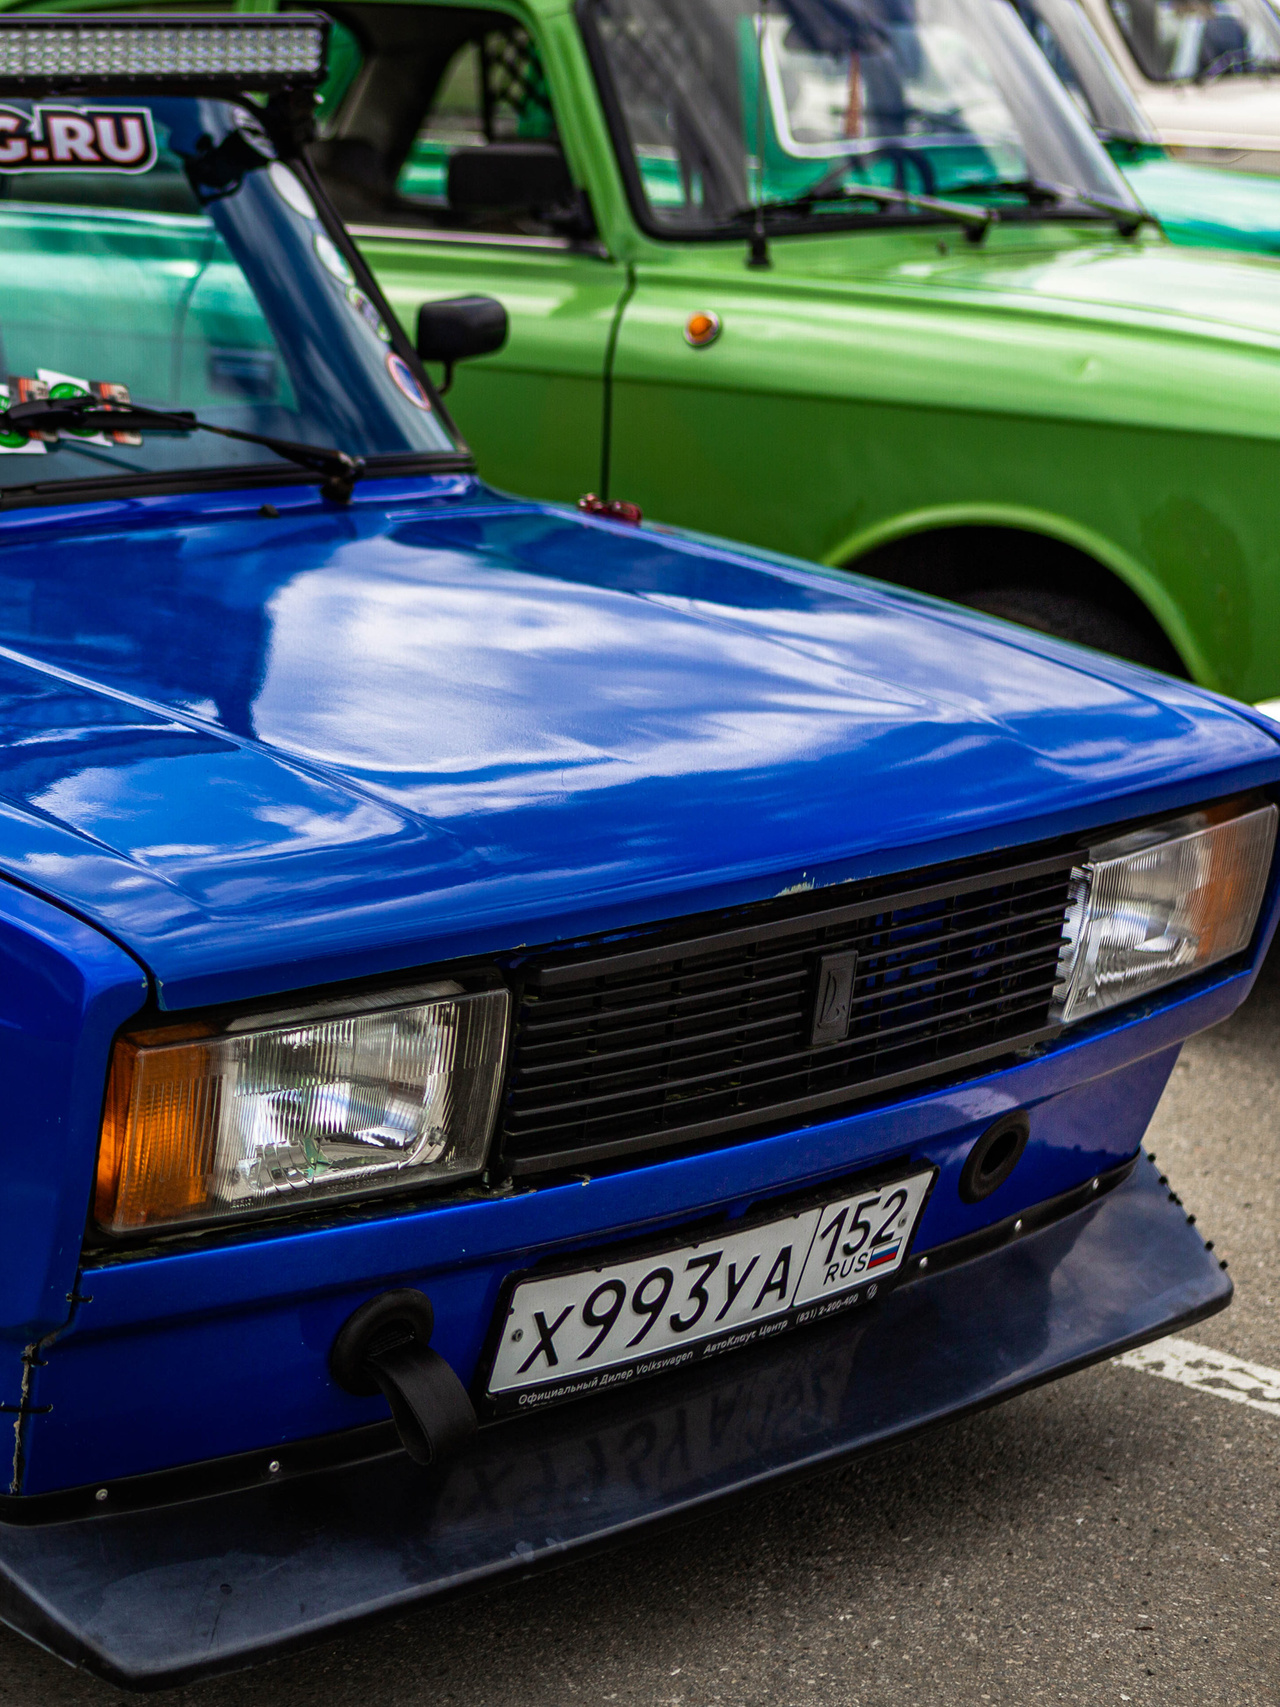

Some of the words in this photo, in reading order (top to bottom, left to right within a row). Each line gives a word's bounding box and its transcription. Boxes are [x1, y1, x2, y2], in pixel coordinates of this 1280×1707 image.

[821, 1188, 909, 1265] 152
[823, 1250, 869, 1286] RUS
[704, 1330, 757, 1354] АвтоКлаус
[758, 1319, 789, 1337] Центр
[518, 1376, 598, 1405] Официальный
[600, 1369, 634, 1387] Дилер
[636, 1350, 694, 1374] Volkswagen
